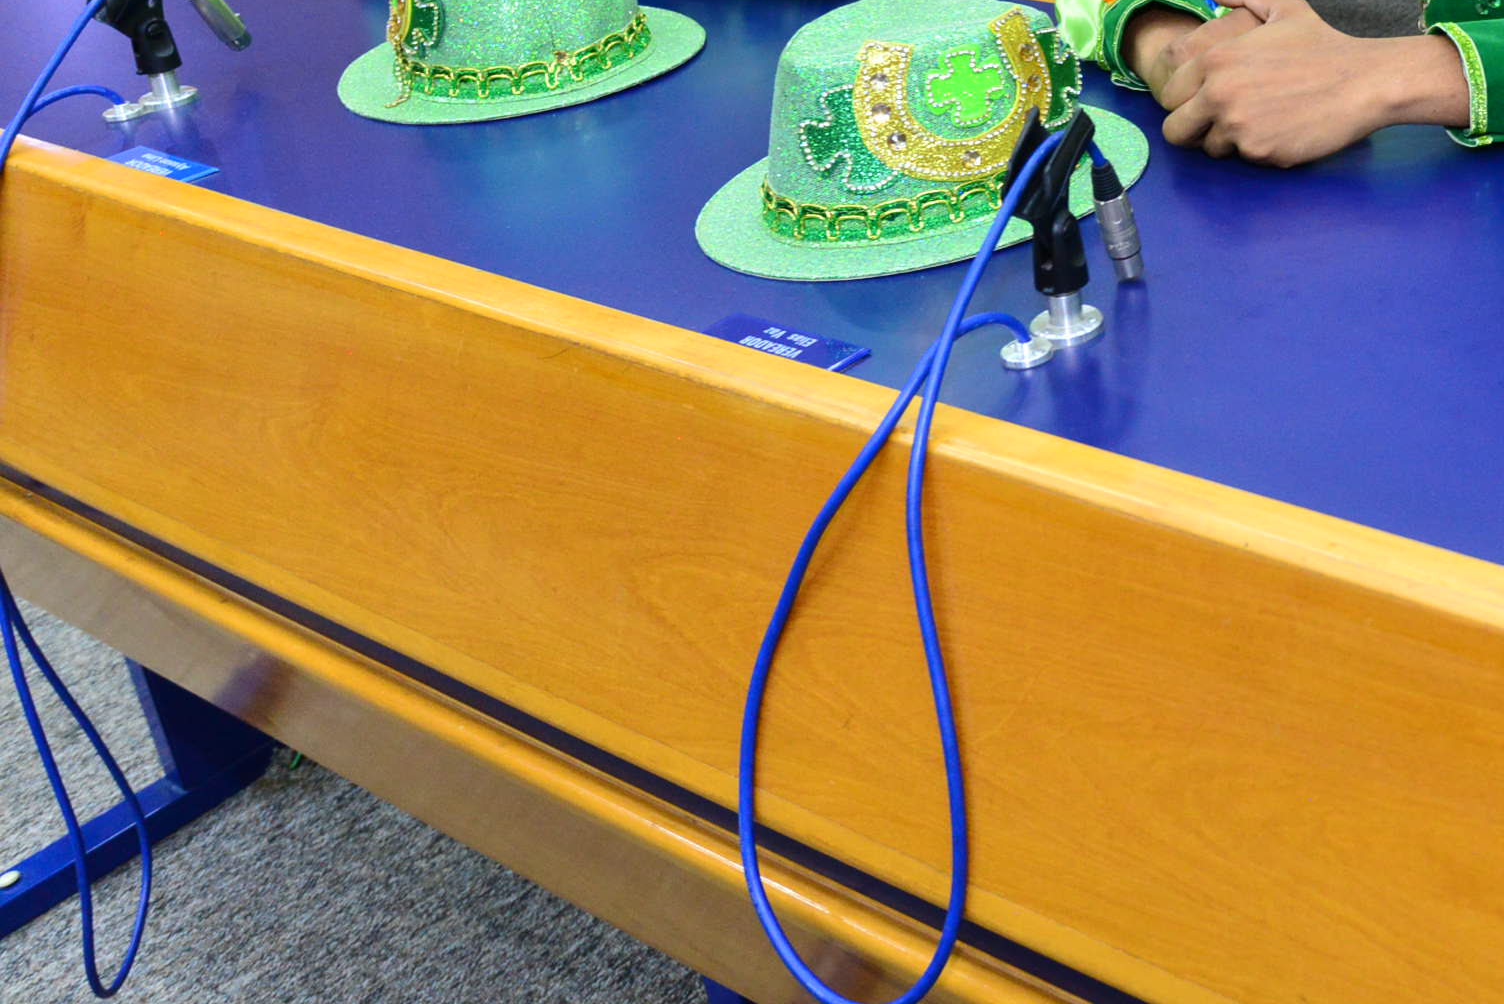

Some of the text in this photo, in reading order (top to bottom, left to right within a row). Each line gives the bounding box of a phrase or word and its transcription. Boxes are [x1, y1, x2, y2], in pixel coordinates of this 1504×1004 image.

[738, 334, 803, 359] VEREADOR
[763, 326, 818, 347] Elias Vaz
